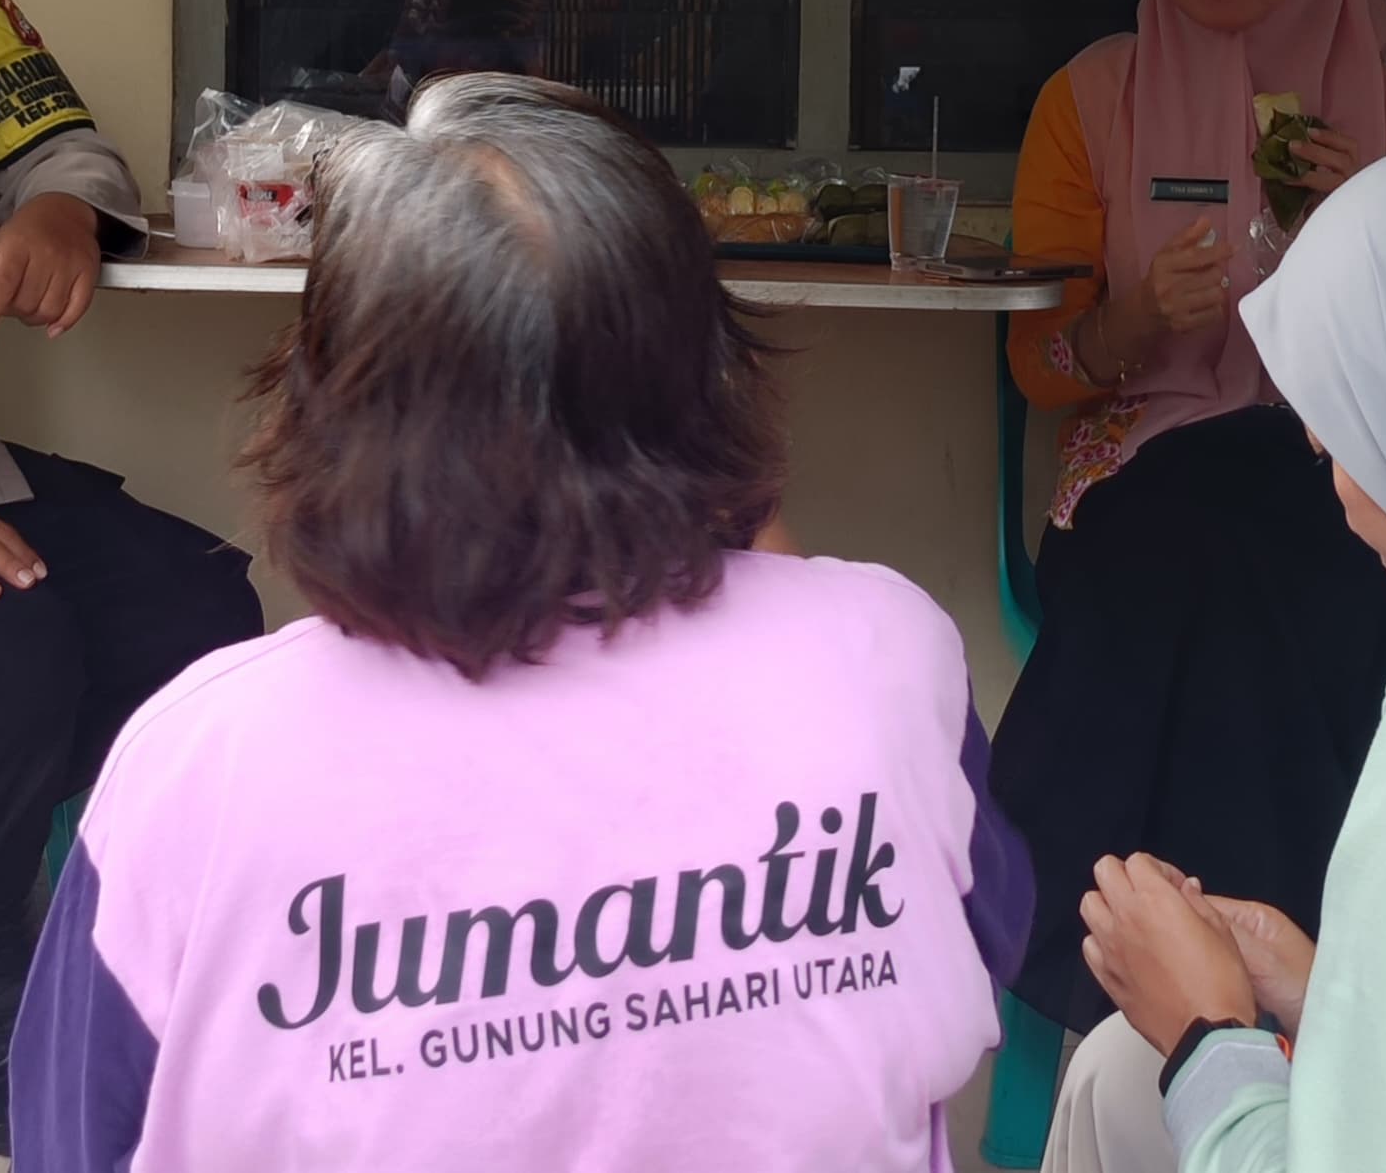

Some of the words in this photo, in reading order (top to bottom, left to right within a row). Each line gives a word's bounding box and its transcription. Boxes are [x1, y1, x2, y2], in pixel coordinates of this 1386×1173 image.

[257, 792, 904, 1030] Jumantik
[328, 1038, 405, 1083] KEL.
[419, 1002, 611, 1069] GUNUNG
[625, 972, 780, 1031] SAHARI
[793, 949, 898, 1001] UTARA
